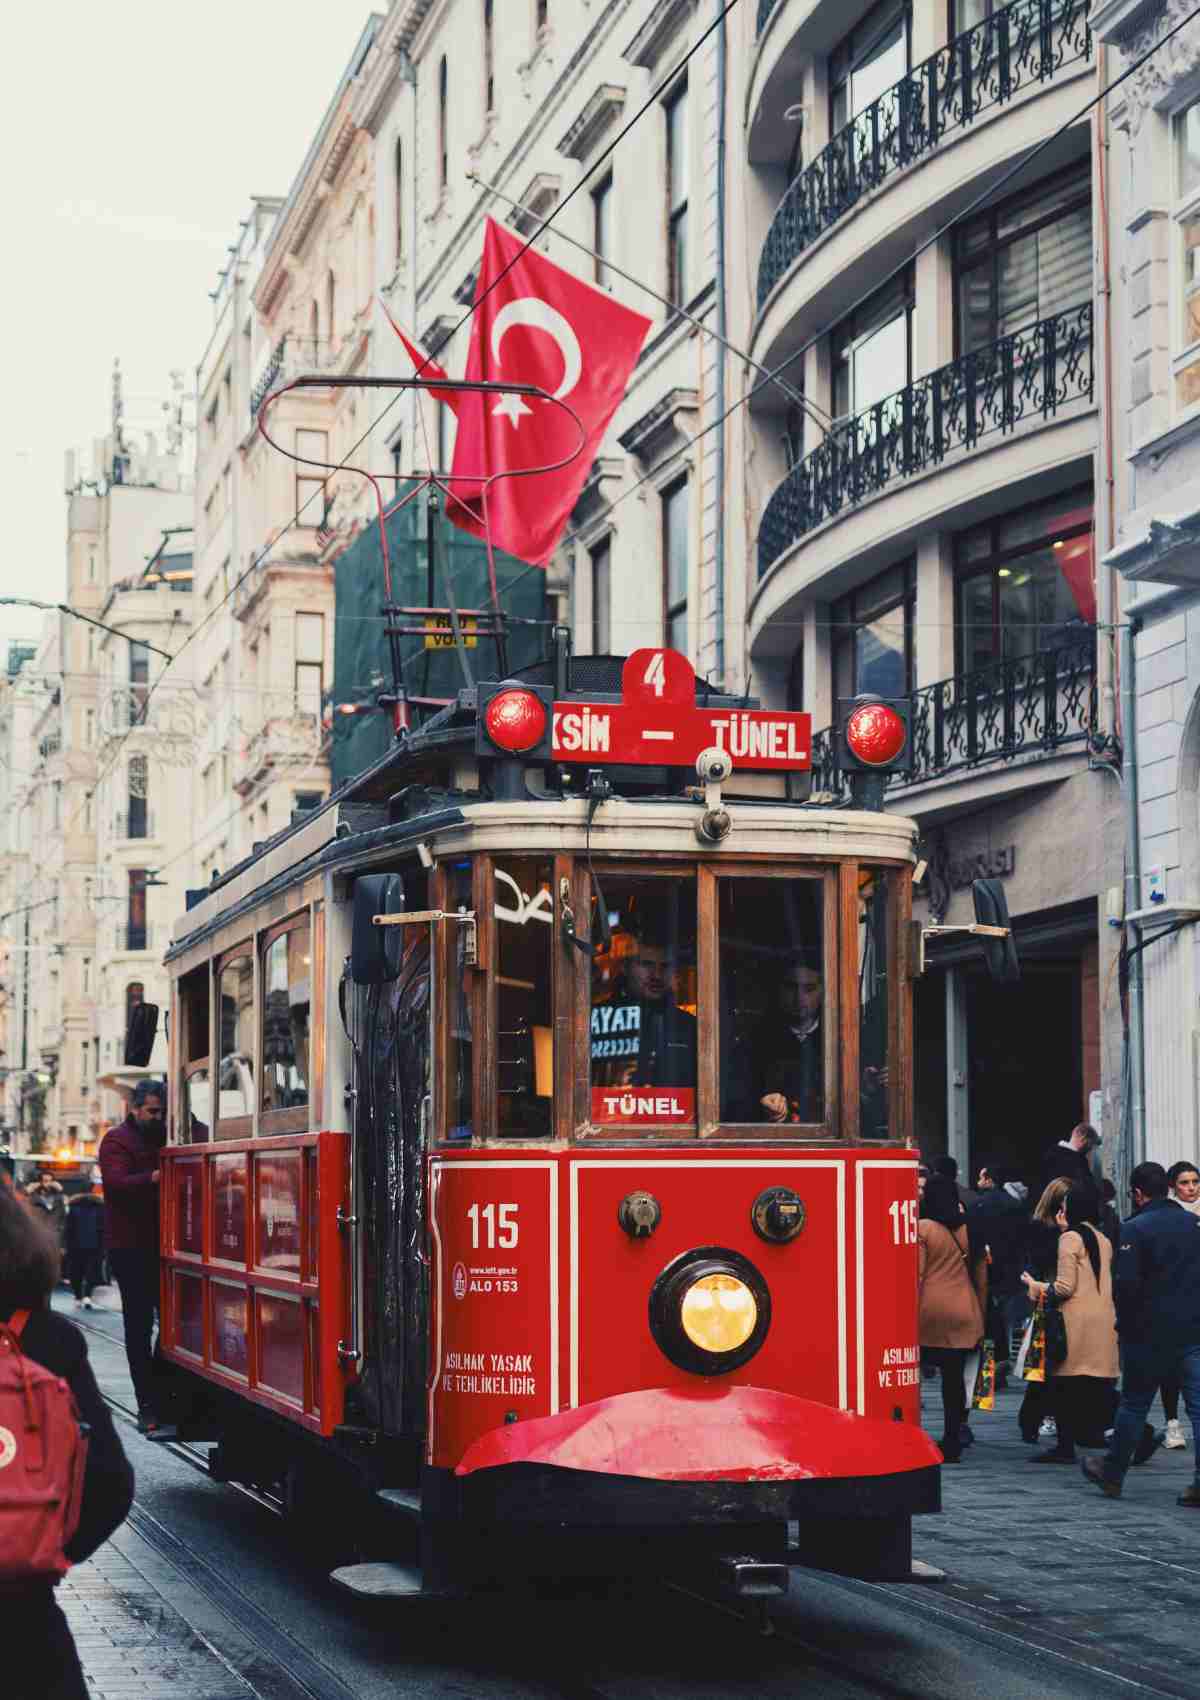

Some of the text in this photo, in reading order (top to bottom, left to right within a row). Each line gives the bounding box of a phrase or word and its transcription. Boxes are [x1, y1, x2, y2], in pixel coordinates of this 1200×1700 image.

[643, 653, 666, 697] 4
[710, 714, 807, 760] TÜNEL
[603, 1093, 685, 1115] TÜNEL
[467, 1203, 519, 1249] 115
[495, 1280, 519, 1292] 153
[490, 1353, 533, 1373] YASAK
[878, 1370, 893, 1388] VE
